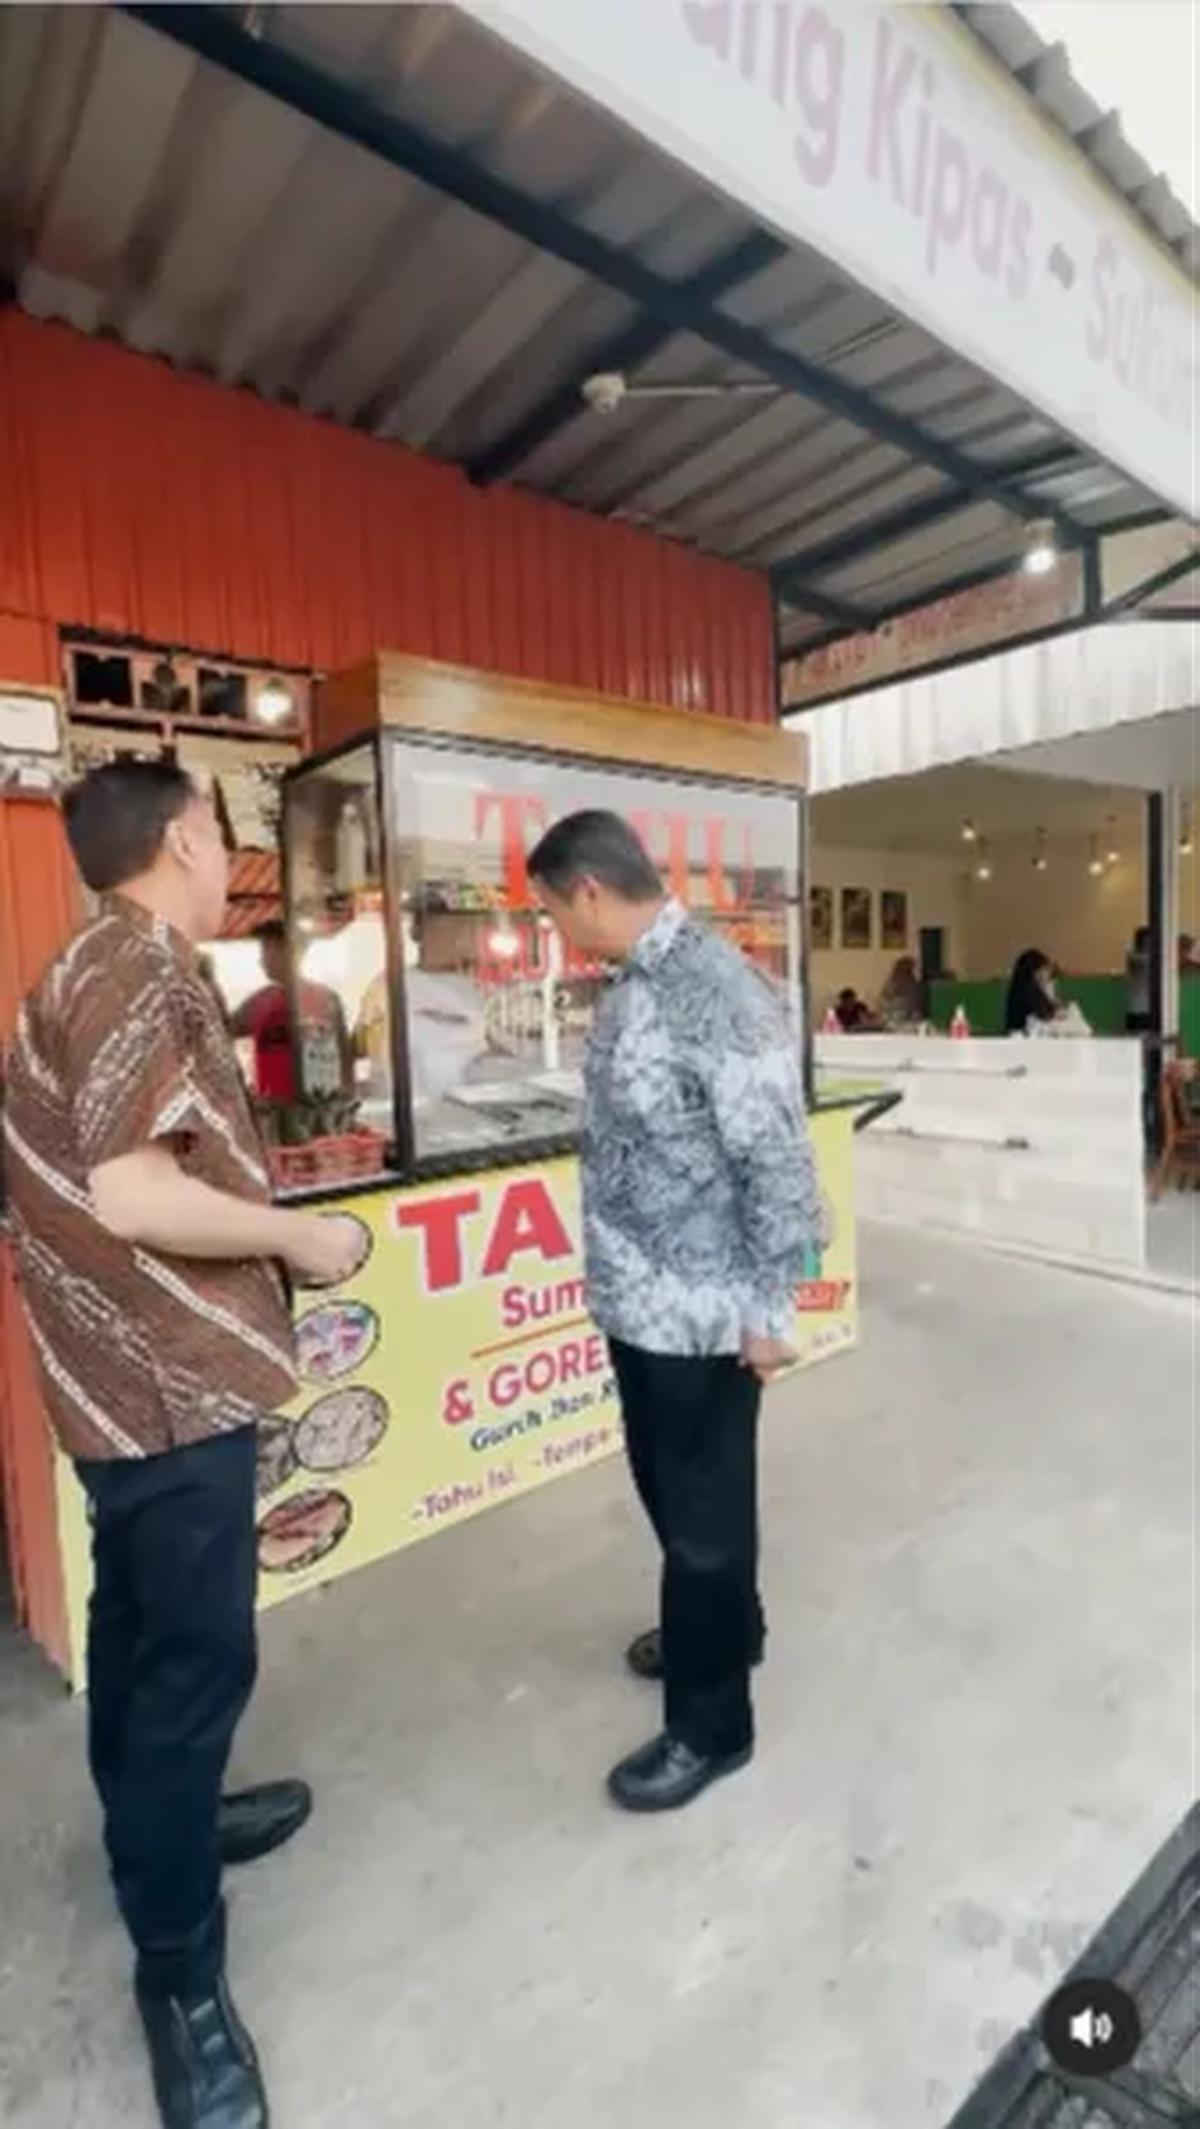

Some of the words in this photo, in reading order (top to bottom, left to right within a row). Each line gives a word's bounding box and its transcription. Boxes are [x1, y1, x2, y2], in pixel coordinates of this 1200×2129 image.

[864, 16, 1035, 302] Kipas
[472, 790, 758, 912] THU
[443, 1379, 475, 1425] &
[488, 1333, 604, 1408] GORE
